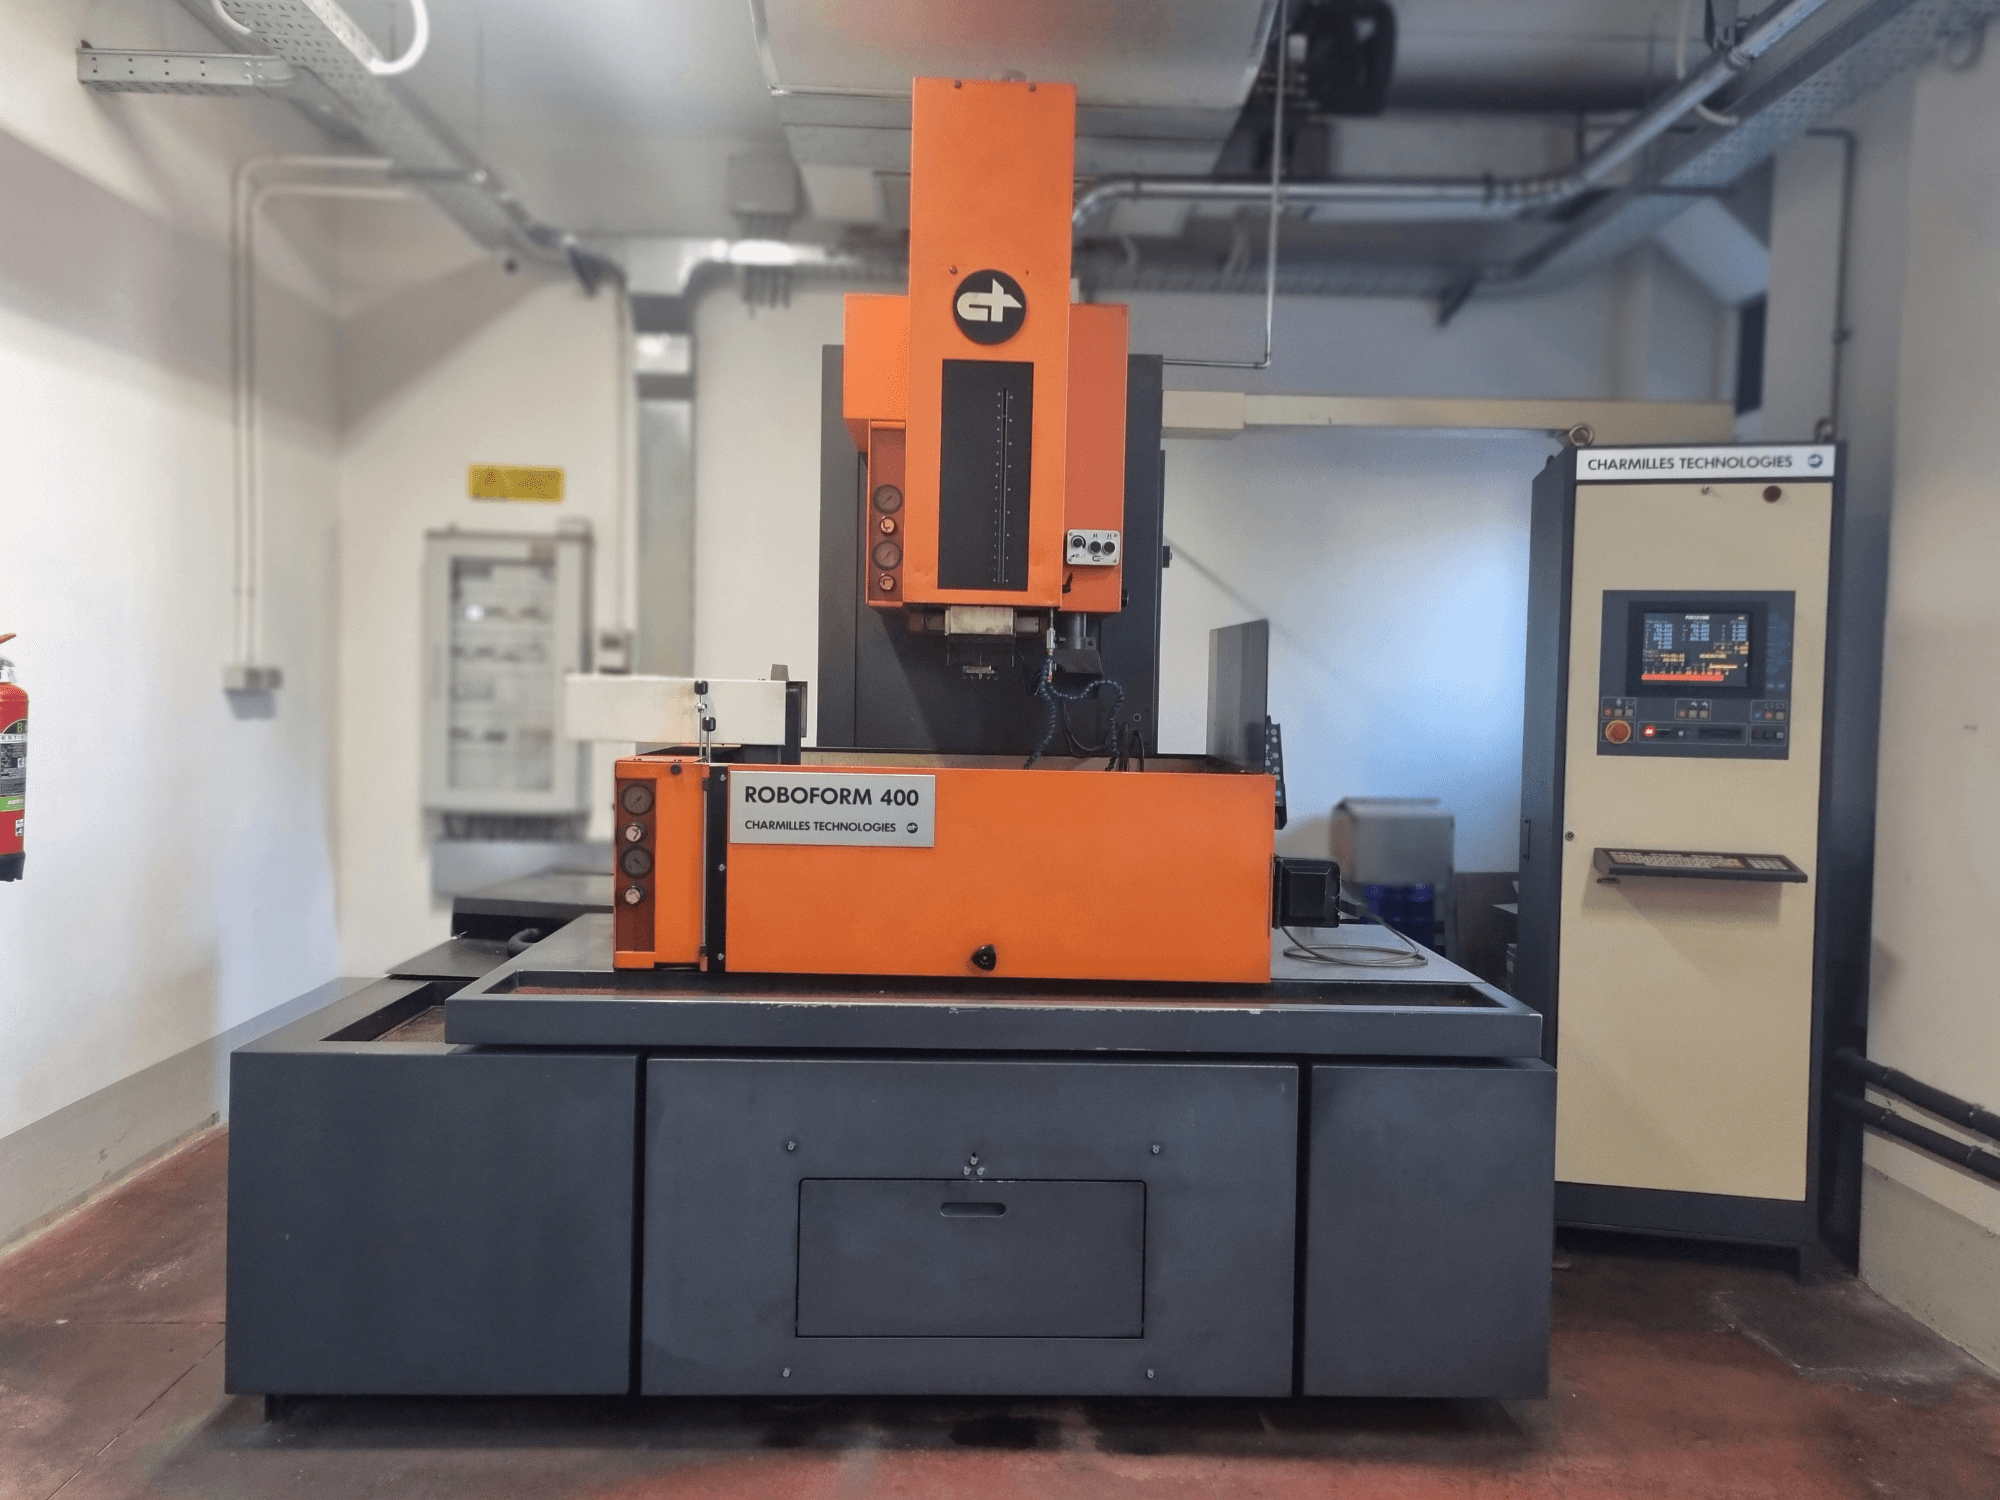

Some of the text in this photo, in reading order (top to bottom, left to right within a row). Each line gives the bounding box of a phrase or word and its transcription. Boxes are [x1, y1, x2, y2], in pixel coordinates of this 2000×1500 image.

[1587, 455, 1793, 471] CHARMILLES TECHNOLOGIES
[745, 786, 919, 806] ROBOFORM 400
[744, 820, 896, 832] CHARMILLES TECHNOLOGIES
